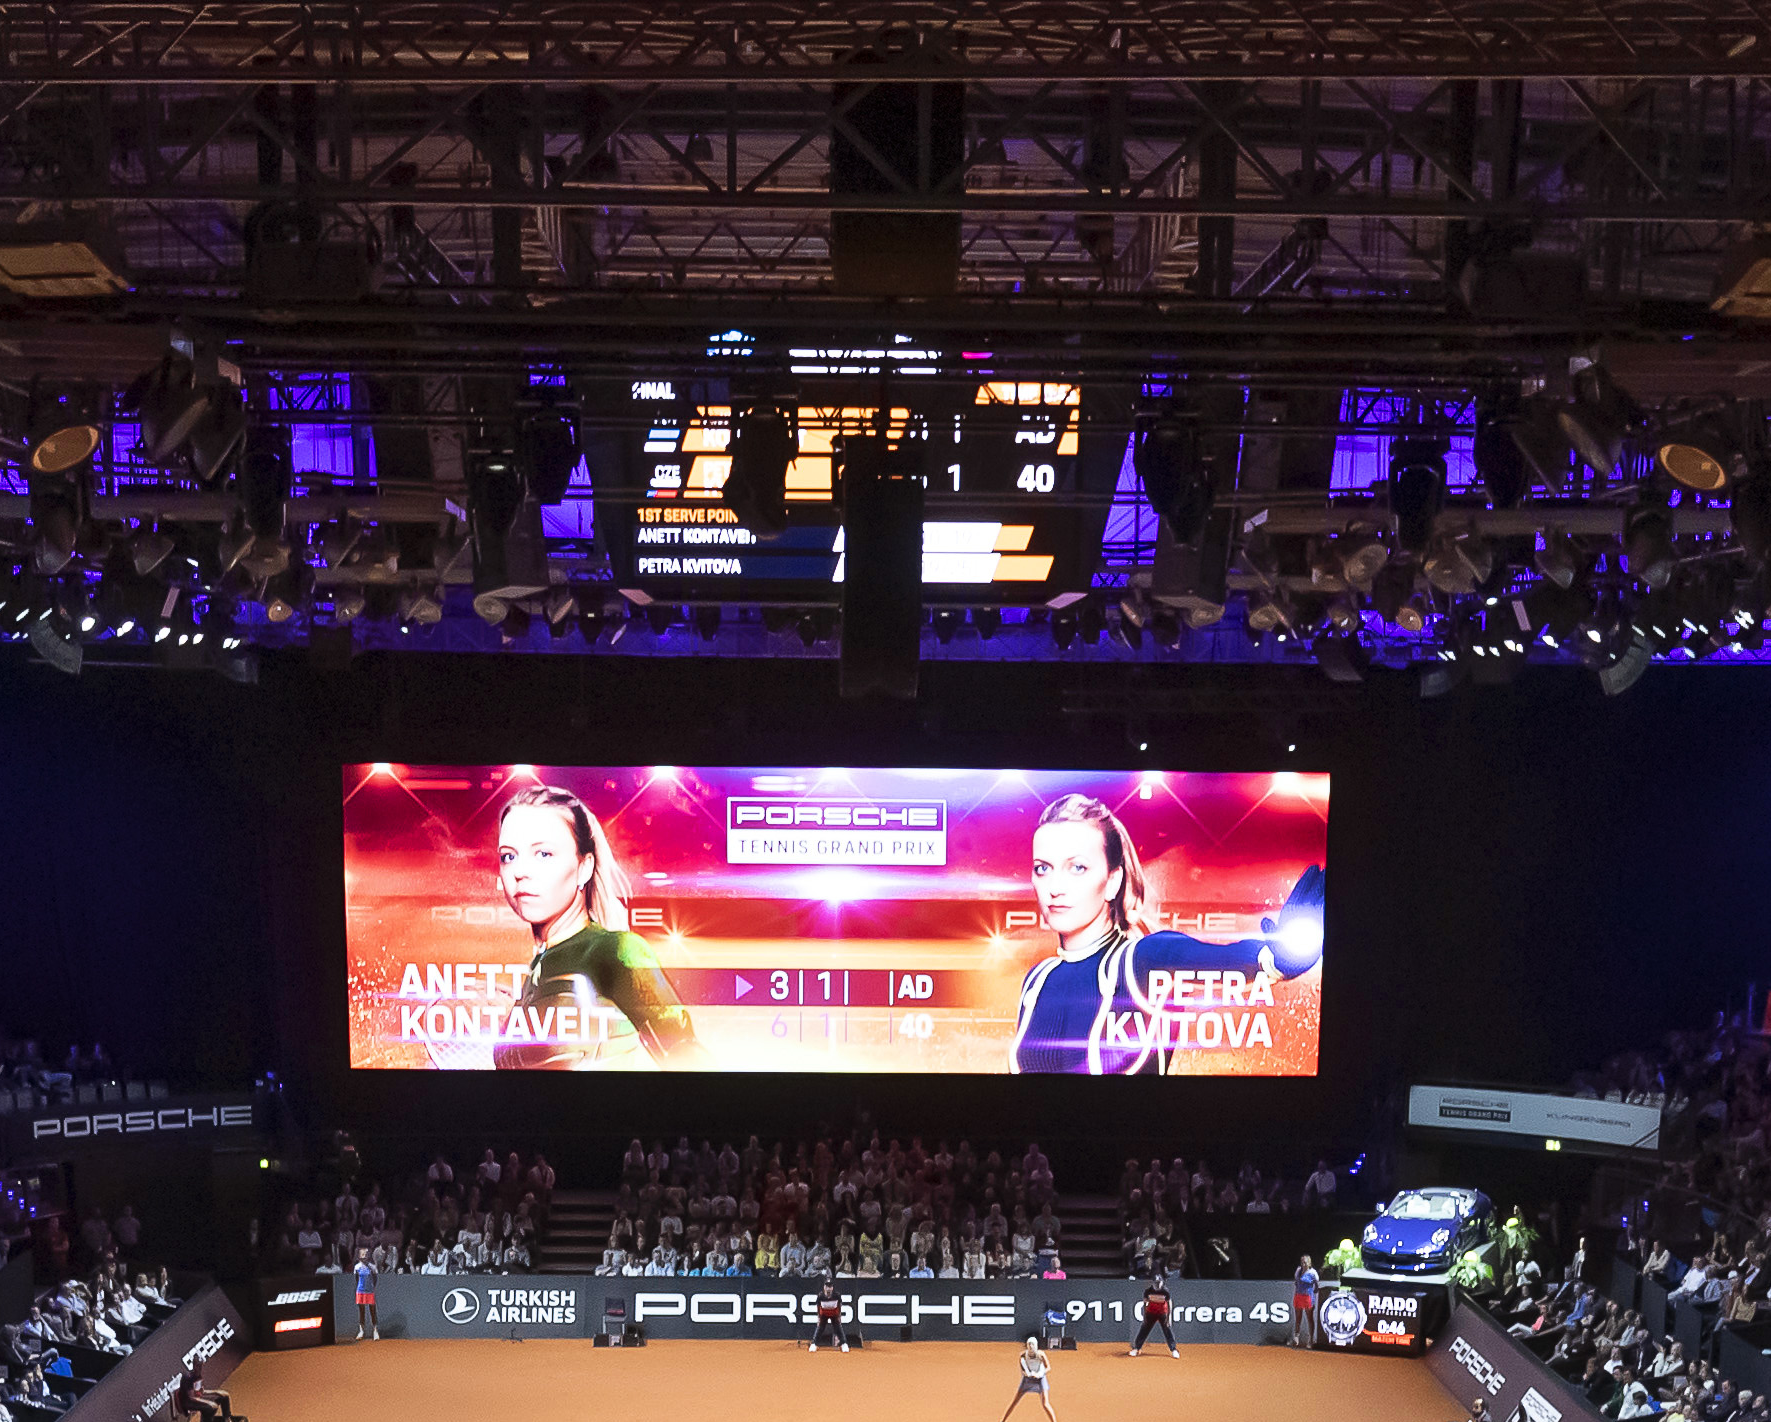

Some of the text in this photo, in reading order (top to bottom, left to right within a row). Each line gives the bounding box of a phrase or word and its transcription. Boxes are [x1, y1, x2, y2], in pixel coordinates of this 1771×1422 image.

[655, 464, 681, 479] CZE
[947, 464, 960, 491] 1
[1017, 464, 1055, 492] 40
[637, 508, 663, 523] 1ST
[664, 508, 705, 523] SERVE
[637, 528, 681, 543] ANETT
[638, 559, 741, 574] PETRA KVITOVA
[736, 806, 938, 826] PORSCHE
[739, 840, 935, 855] TENNIS GRAND PRIX
[399, 963, 529, 999] ANETT
[770, 970, 934, 1000] 3 1 AD
[1148, 970, 1274, 1006] PETRA
[400, 1005, 617, 1042] KONTAVEIT
[772, 1012, 787, 1038] 6
[898, 1013, 935, 1038] 40
[1107, 1012, 1273, 1048] KVITOVA
[34, 1105, 252, 1139] PORSCHE
[268, 1289, 327, 1305] BOSE
[487, 1289, 575, 1306] TURKISH
[1369, 1295, 1418, 1312] RADO
[486, 1307, 576, 1323] AIRLINES
[1066, 1300, 1123, 1322] 911
[1249, 1302, 1290, 1323] 4S
[1448, 1335, 1506, 1397] PORSCHE
